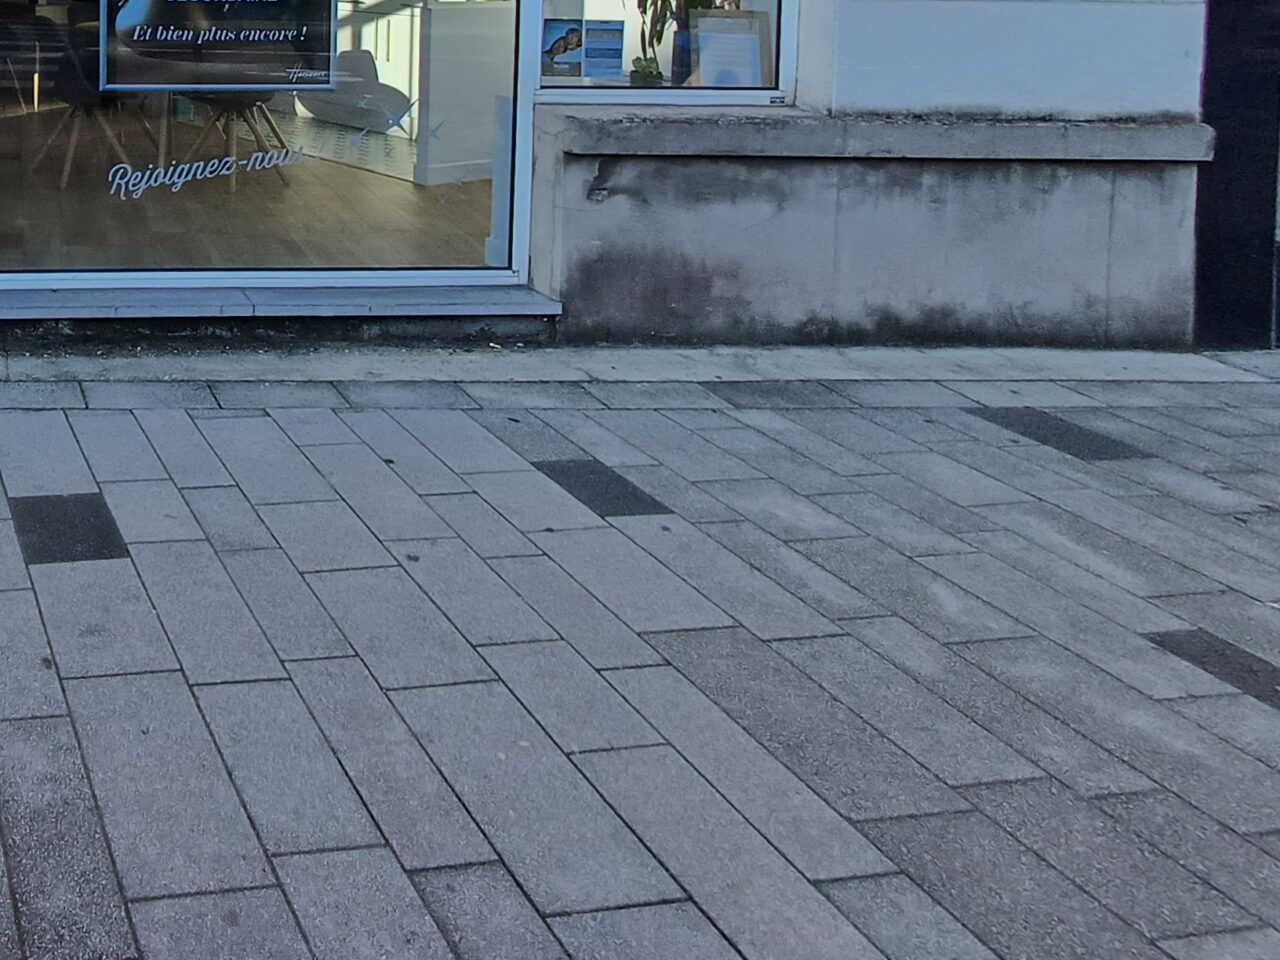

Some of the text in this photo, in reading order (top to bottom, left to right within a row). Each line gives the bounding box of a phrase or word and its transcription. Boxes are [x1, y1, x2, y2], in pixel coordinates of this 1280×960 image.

[133, 26, 153, 40] Et
[156, 26, 194, 41] bien
[197, 26, 236, 45] plus
[240, 28, 297, 41] encore
